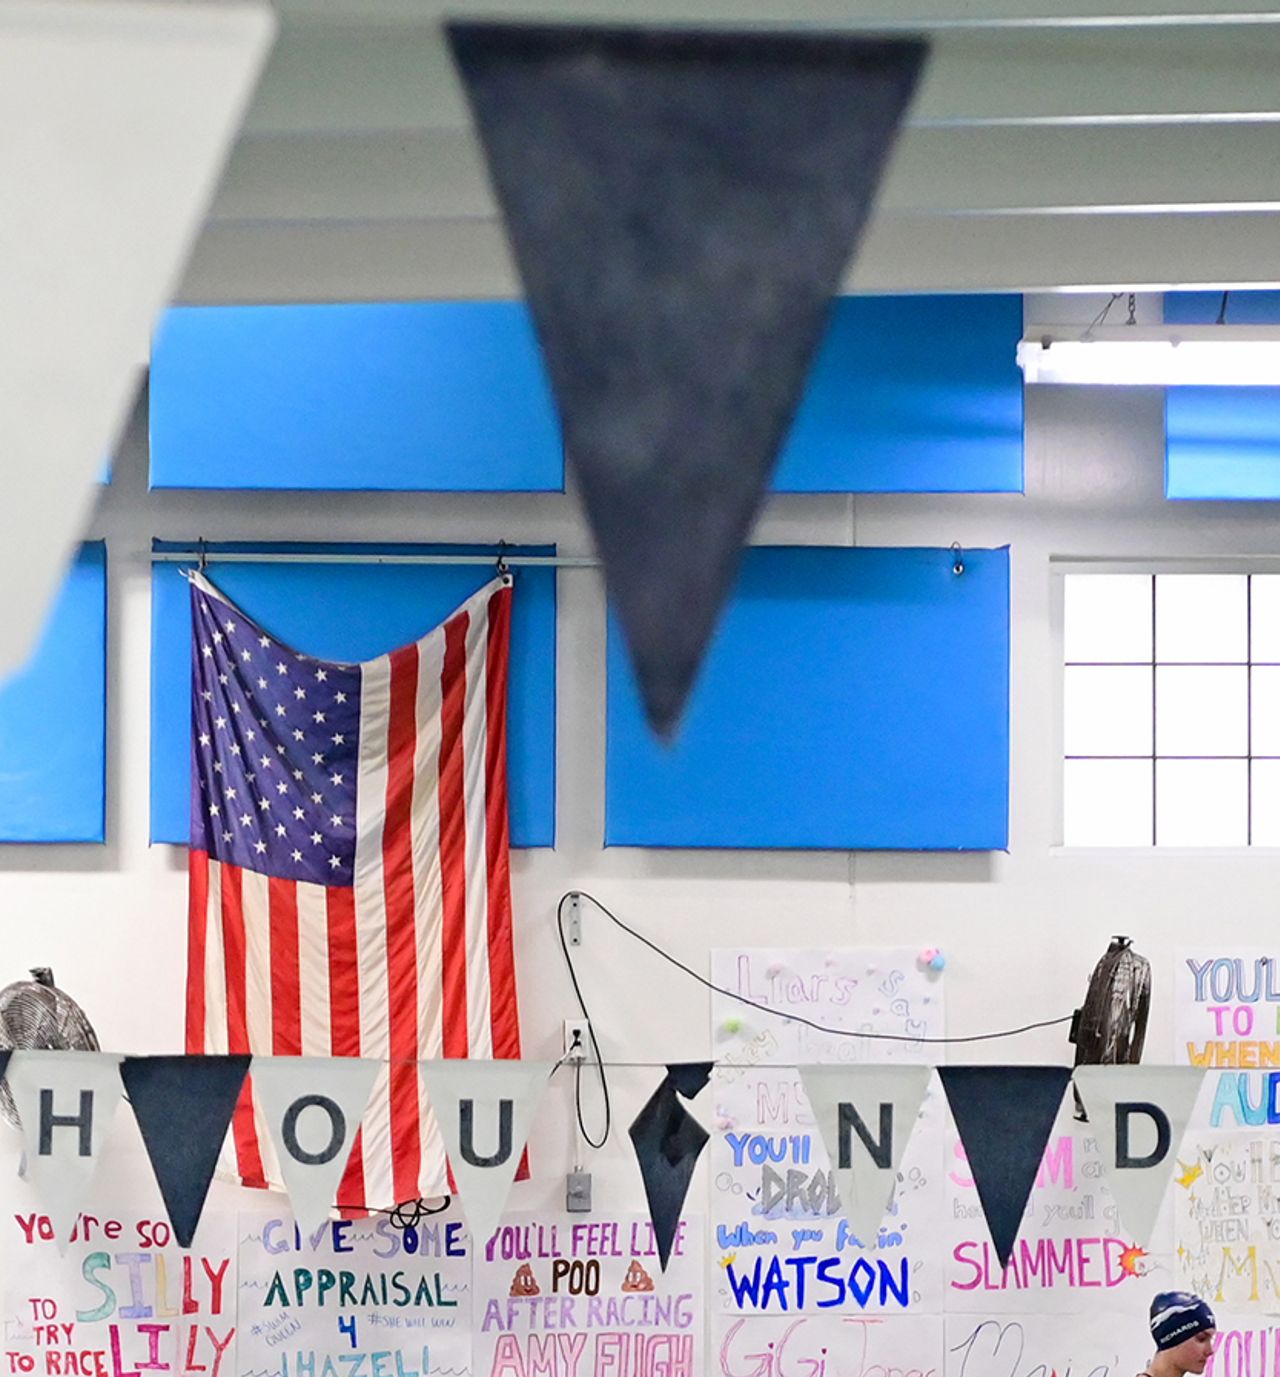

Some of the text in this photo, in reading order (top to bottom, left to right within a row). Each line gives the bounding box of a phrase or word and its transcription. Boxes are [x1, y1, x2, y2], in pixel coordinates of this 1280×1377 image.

[736, 954, 858, 1006] Liars
[1207, 1005, 1255, 1037] TO
[262, 1219, 467, 1259] GIVE SOME
[485, 1222, 562, 1262] YOU'LL
[570, 1222, 623, 1257] FEEL
[551, 1258, 602, 1297] POO
[726, 1254, 910, 1312] WATSON
[950, 1237, 1125, 1291] SLAMMED
[75, 1251, 231, 1322] SILLY
[262, 1267, 459, 1308] APPRAISAL
[28, 1298, 58, 1321] TO
[481, 1293, 694, 1332] AFTER RACING
[32, 1322, 74, 1346] TRY
[337, 1314, 358, 1349] 4
